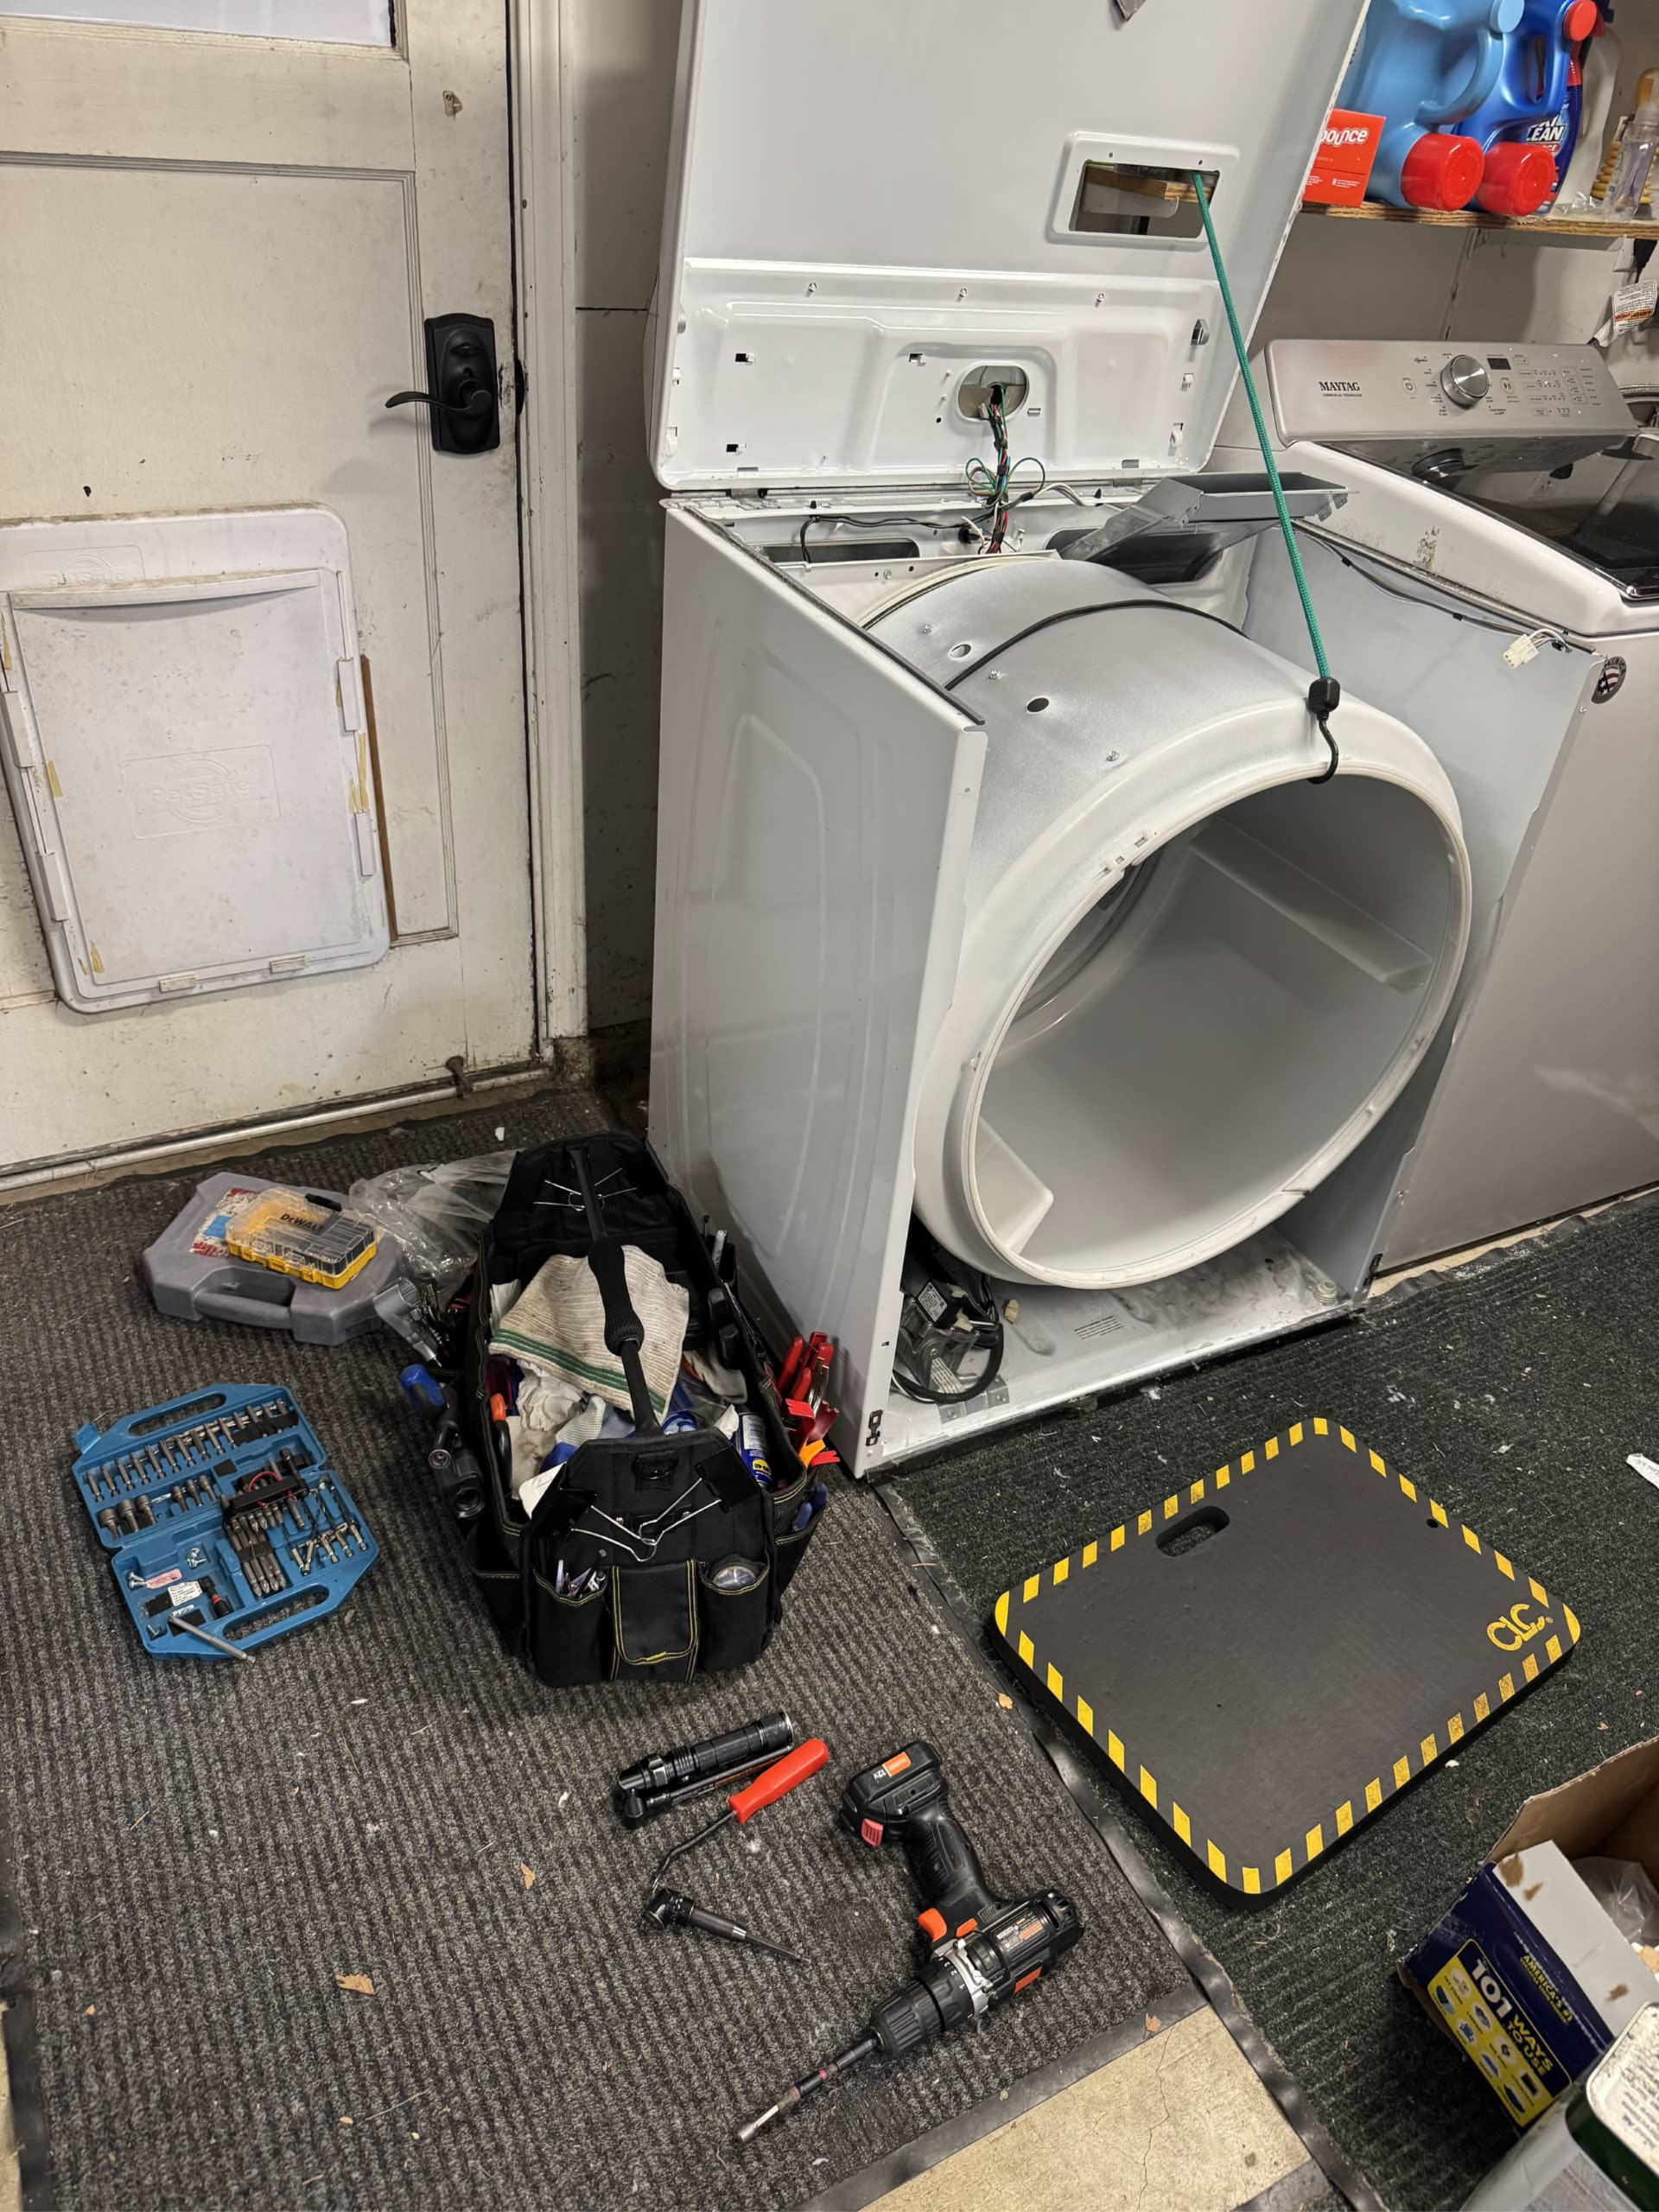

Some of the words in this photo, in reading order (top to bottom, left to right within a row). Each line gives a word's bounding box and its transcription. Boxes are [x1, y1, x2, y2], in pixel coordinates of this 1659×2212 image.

[1319, 381, 1361, 391] MAYTAG
[1487, 1603, 1546, 1651] CLC
[1471, 1958, 1513, 2018] 101
[1523, 1955, 1562, 2007] AMERICA'S
[1507, 2020, 1523, 2044] TO
[1523, 2045, 1547, 2075] USE
[1514, 2013, 1554, 2071] WAYS
